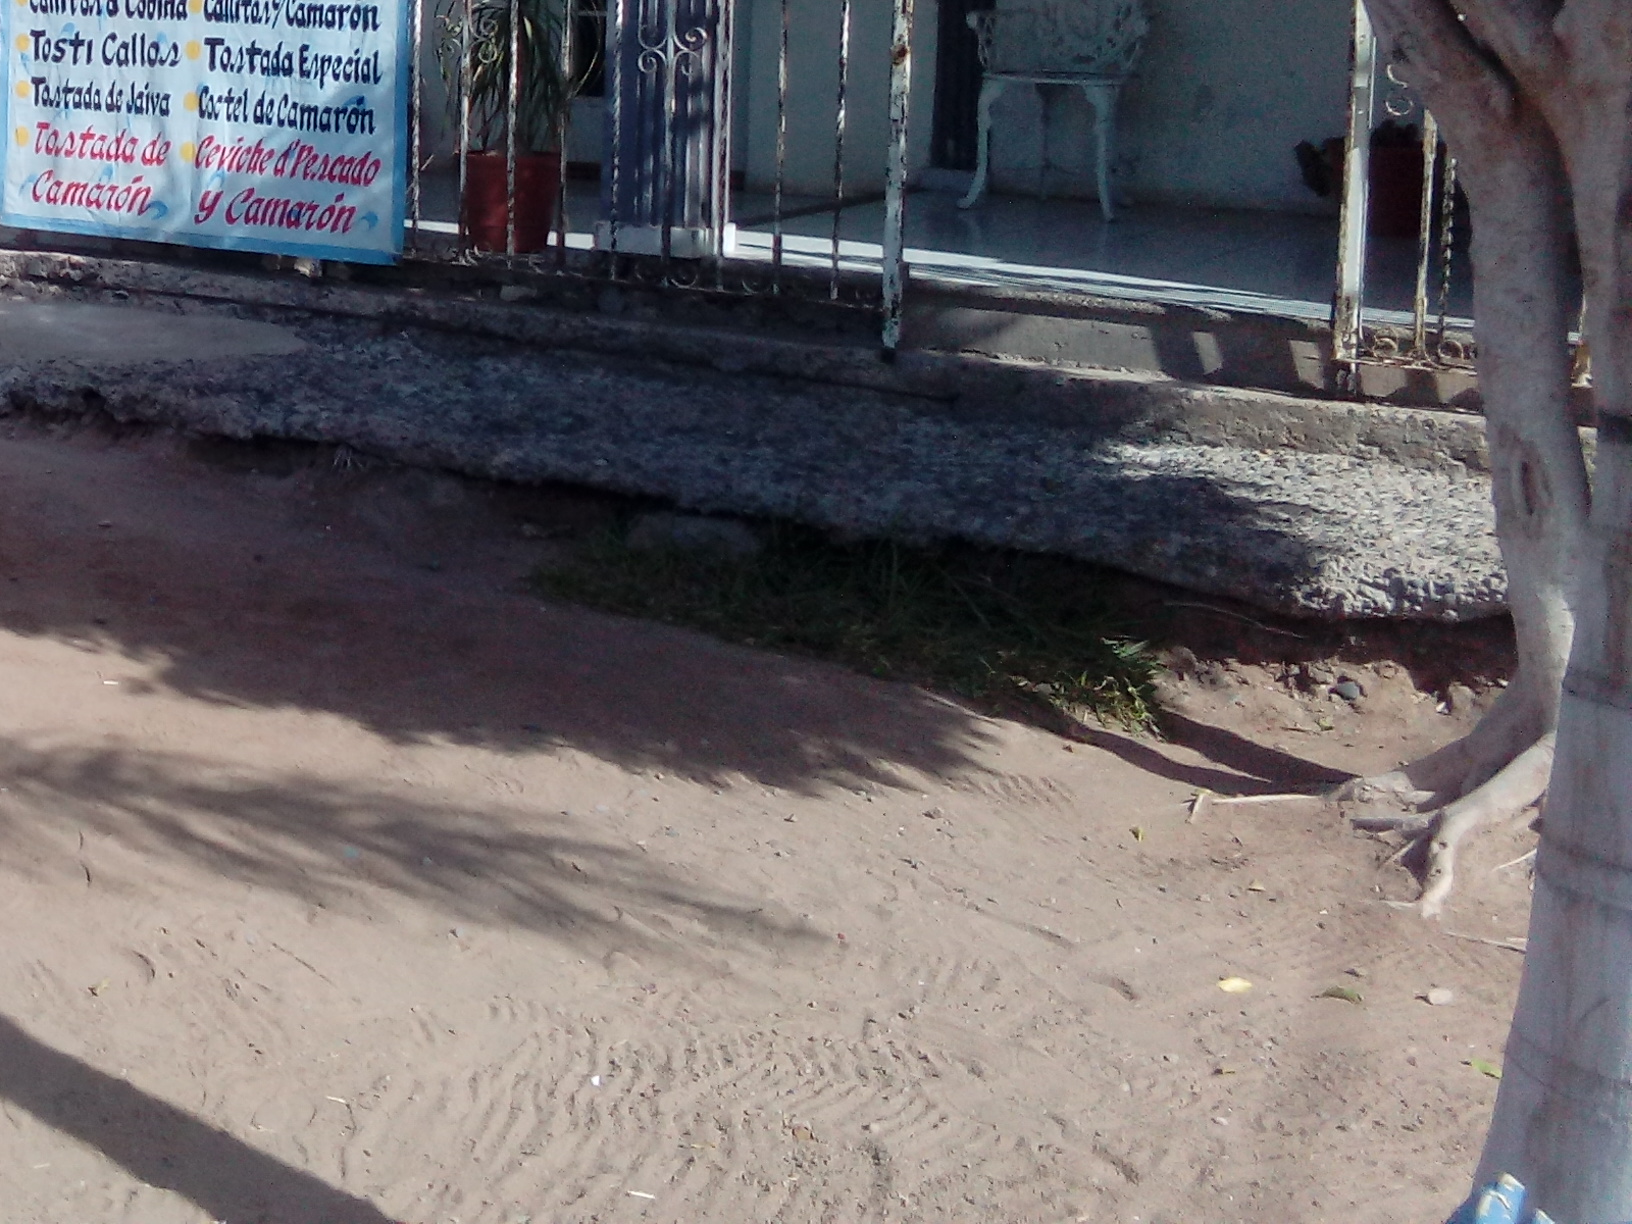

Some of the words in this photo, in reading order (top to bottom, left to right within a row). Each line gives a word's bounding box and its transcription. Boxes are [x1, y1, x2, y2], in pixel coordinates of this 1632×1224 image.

[29, 29, 94, 67] Tosti
[101, 31, 182, 68] Callos
[204, 37, 294, 78] Tostada
[297, 43, 384, 90] Especial
[30, 76, 103, 113] Tostada
[105, 79, 124, 114] de
[125, 81, 172, 118] Jaiva
[252, 90, 275, 127] de
[276, 93, 377, 136] Camarón
[34, 121, 140, 165] Tostada
[141, 130, 172, 167] de
[194, 134, 276, 177] Ceviche
[31, 169, 153, 217] Camarón
[224, 186, 358, 235] Camarón
